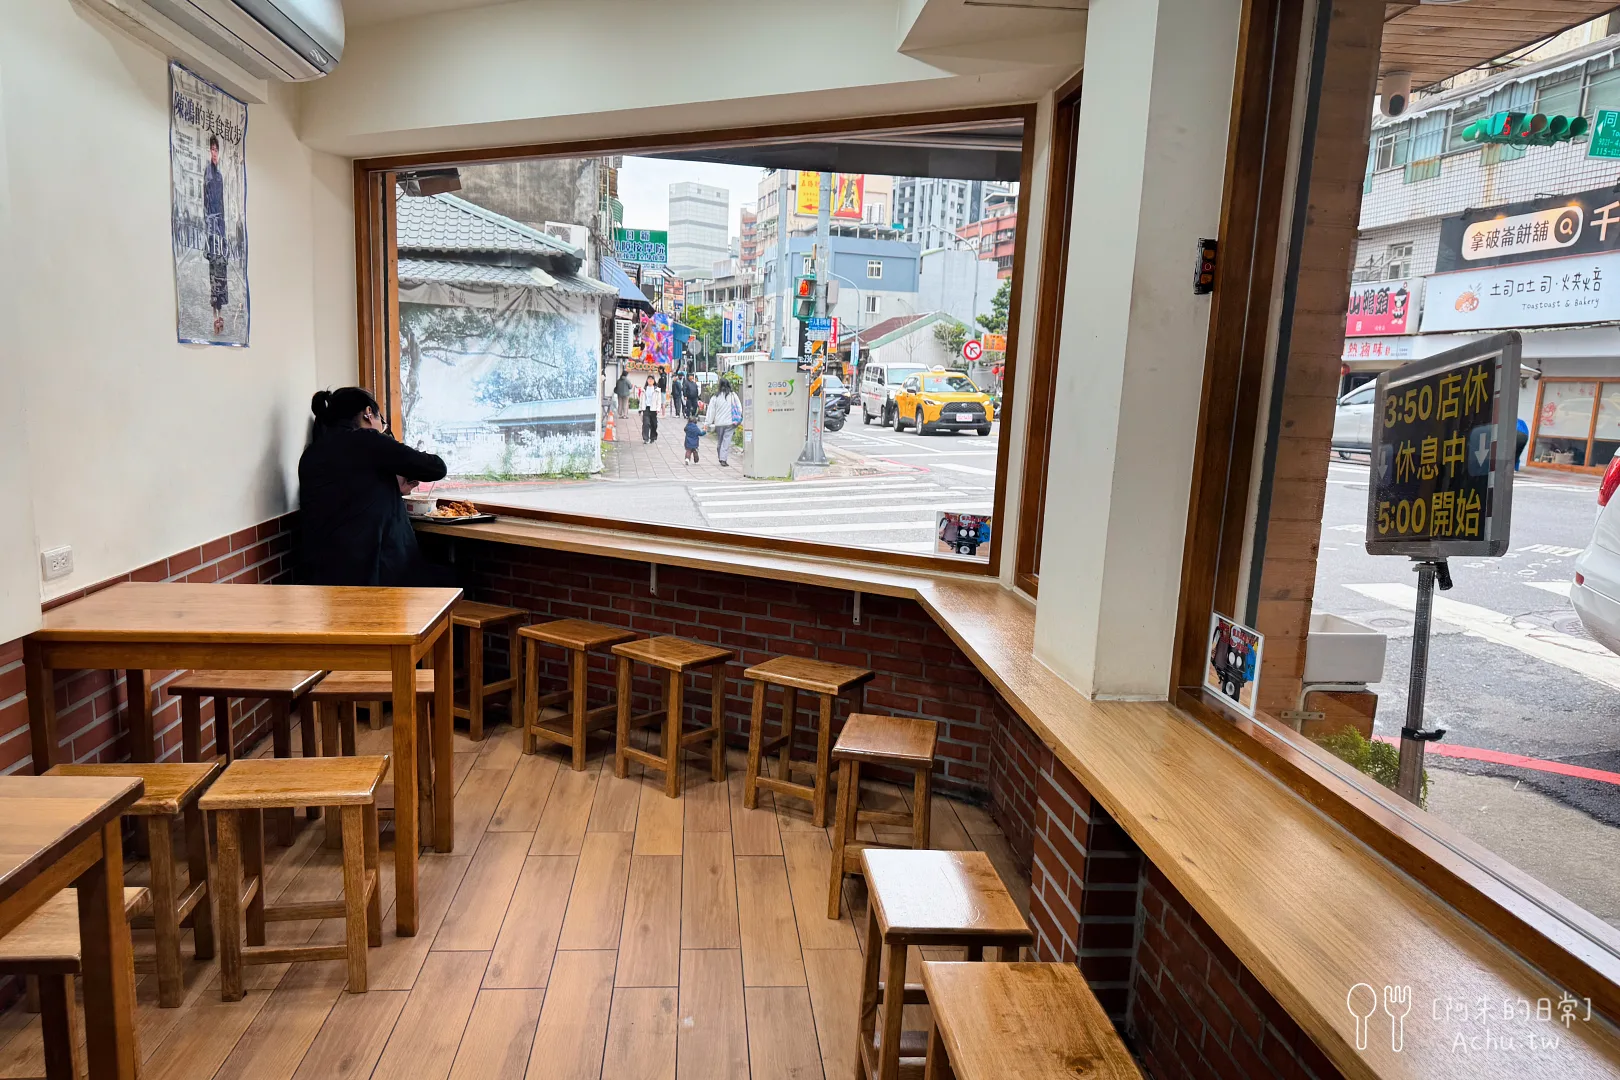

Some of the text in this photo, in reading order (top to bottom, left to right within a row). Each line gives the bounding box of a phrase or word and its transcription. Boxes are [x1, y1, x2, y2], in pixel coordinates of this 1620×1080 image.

[1471, 220, 1550, 252] 拿破崙餅舖
[1574, 297, 1600, 309] Bakery
[1396, 430, 1466, 484] 休息中
